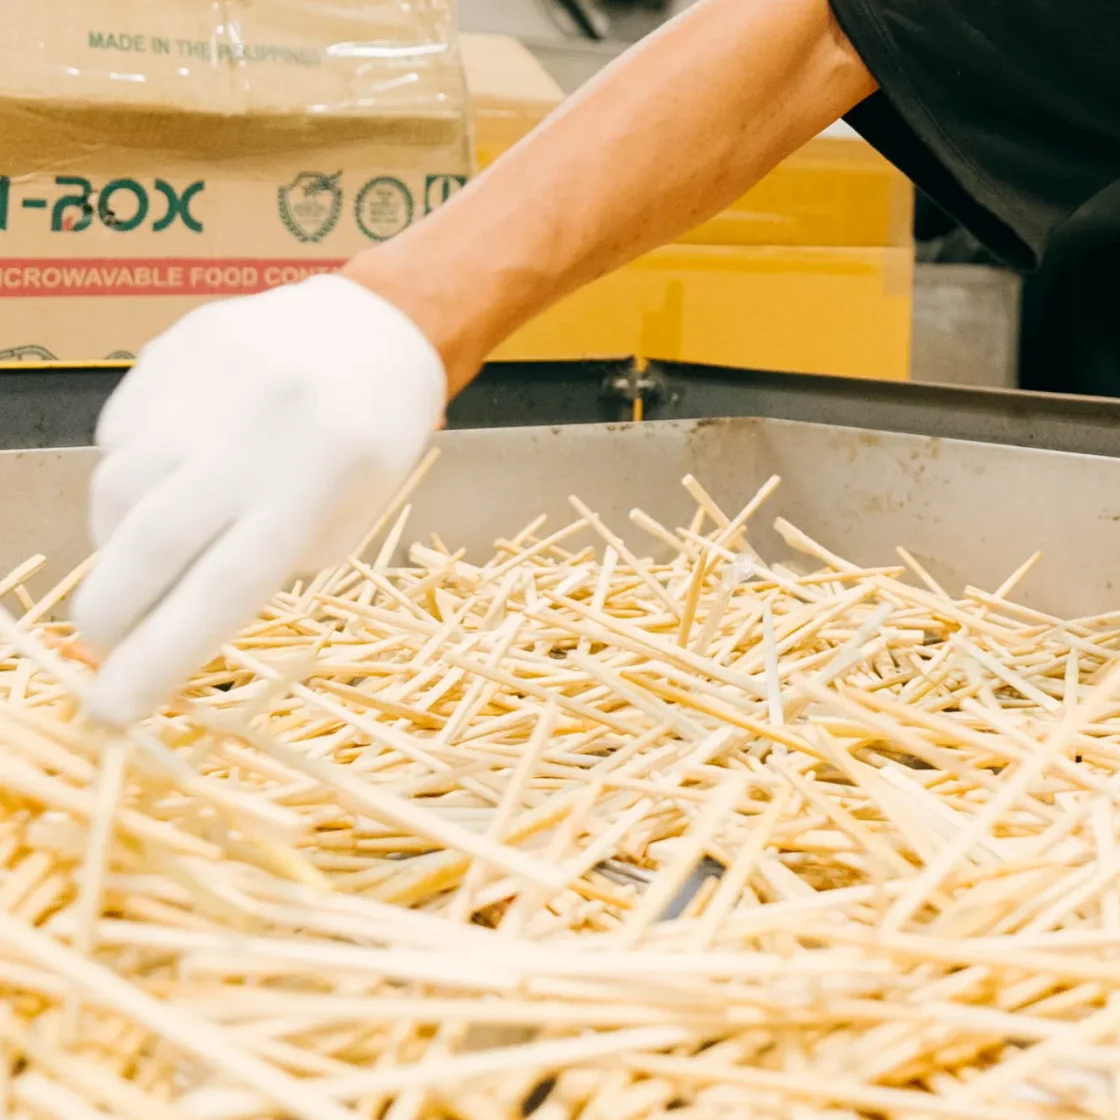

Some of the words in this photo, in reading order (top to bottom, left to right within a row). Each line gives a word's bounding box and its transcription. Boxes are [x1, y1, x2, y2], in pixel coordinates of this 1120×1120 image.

[88, 31, 146, 52] MADE
[151, 37, 170, 55] IN
[190, 266, 258, 288] FOOD
